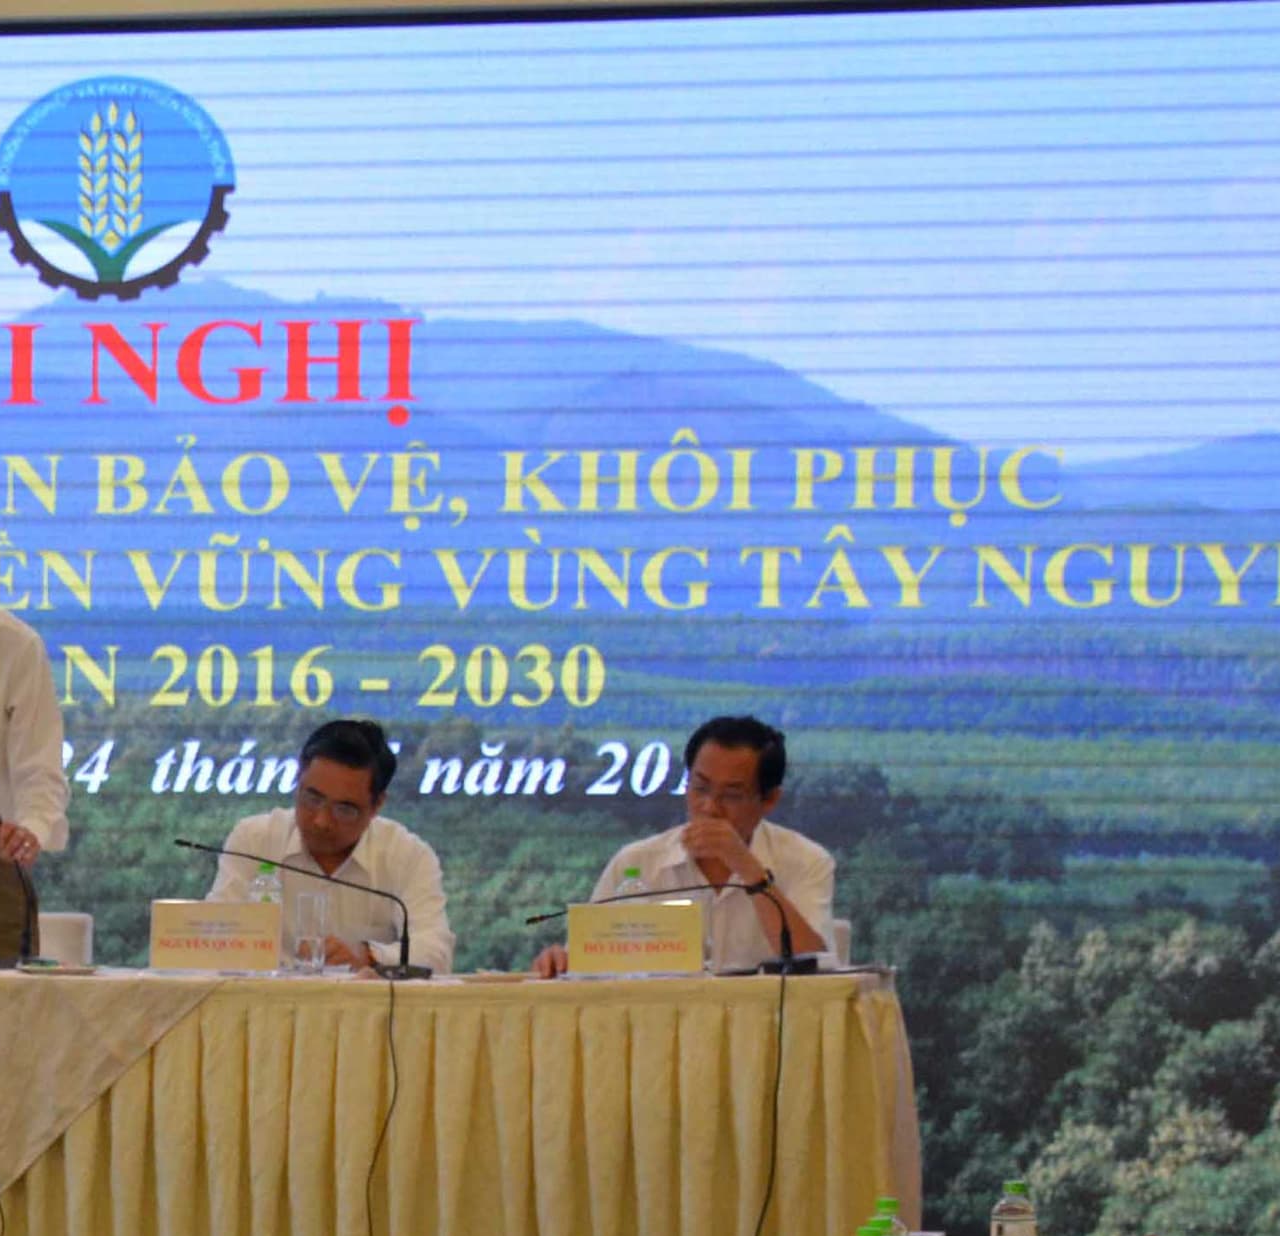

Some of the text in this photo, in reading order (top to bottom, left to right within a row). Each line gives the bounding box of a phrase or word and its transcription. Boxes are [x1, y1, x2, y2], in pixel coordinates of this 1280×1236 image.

[81, 318, 421, 427] NGHỊ
[93, 434, 291, 515] BẢO
[315, 440, 469, 531] VỆ,
[498, 428, 758, 513] KHÔI
[790, 444, 1065, 528] PHỤC
[126, 531, 405, 611] VỮNG
[433, 527, 712, 611] VÙNG
[739, 523, 947, 609] TÂY
[149, 644, 334, 707] 2016
[360, 677, 390, 692] -
[417, 643, 606, 708] 2030
[61, 739, 115, 794] 4
[151, 739, 300, 794] thán
[420, 740, 566, 796] năm
